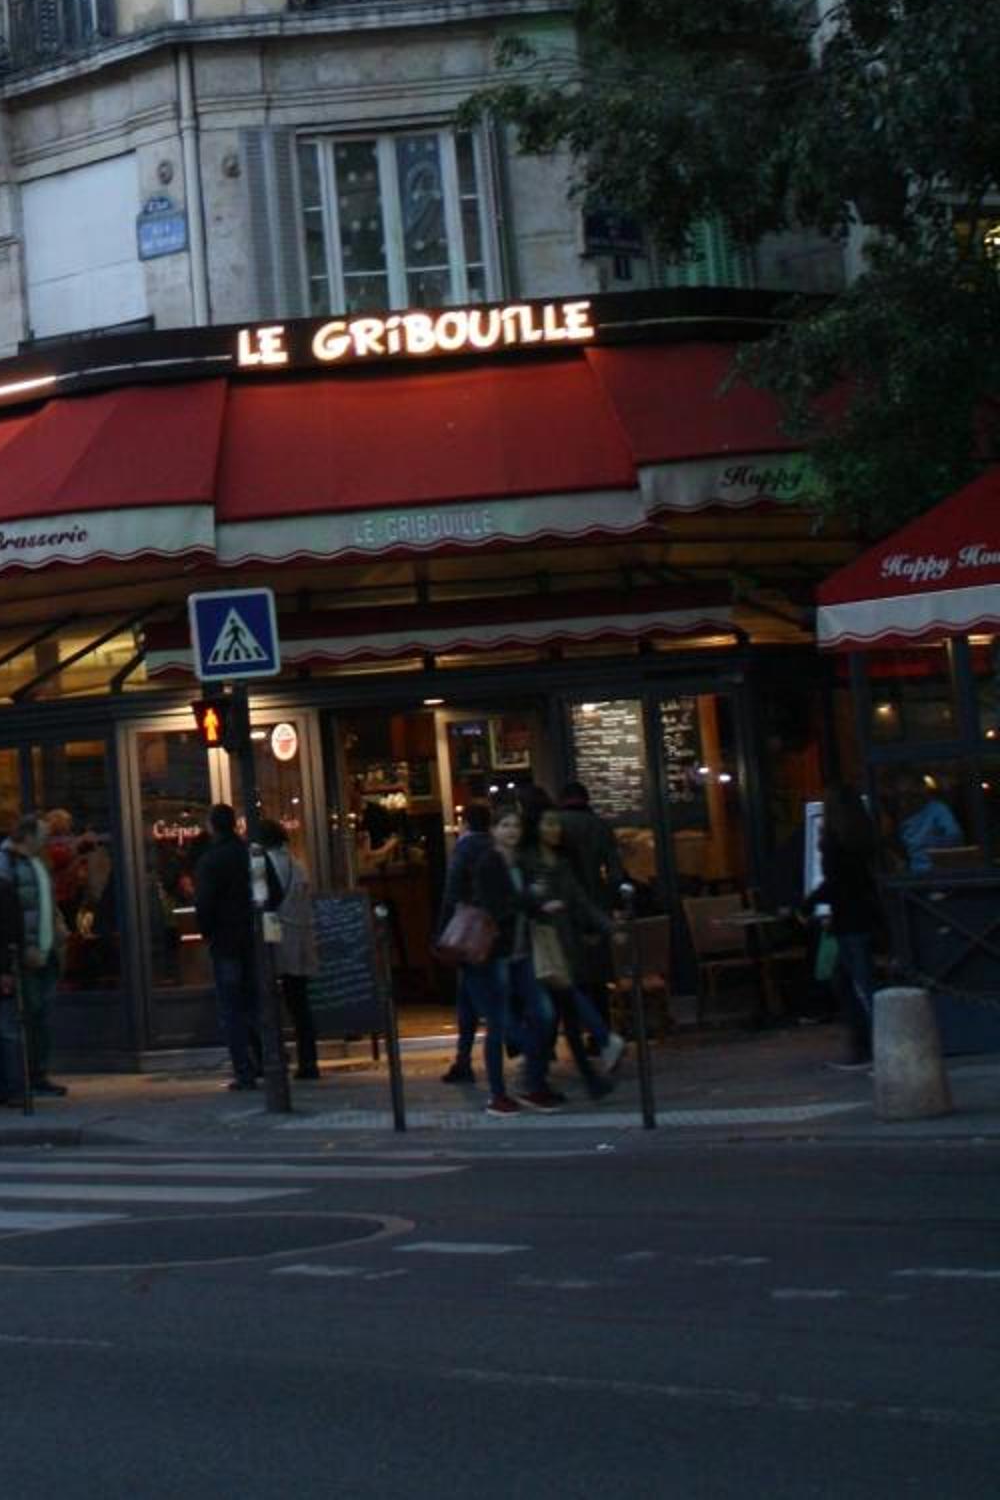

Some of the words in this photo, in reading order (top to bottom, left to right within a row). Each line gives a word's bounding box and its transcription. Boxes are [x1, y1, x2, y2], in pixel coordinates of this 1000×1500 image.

[237, 326, 288, 366] LE
[355, 519, 375, 542] LE
[385, 510, 493, 541] GRIBOUILLE
[881, 554, 950, 582] Happy
[957, 544, 1000, 568] Hou
